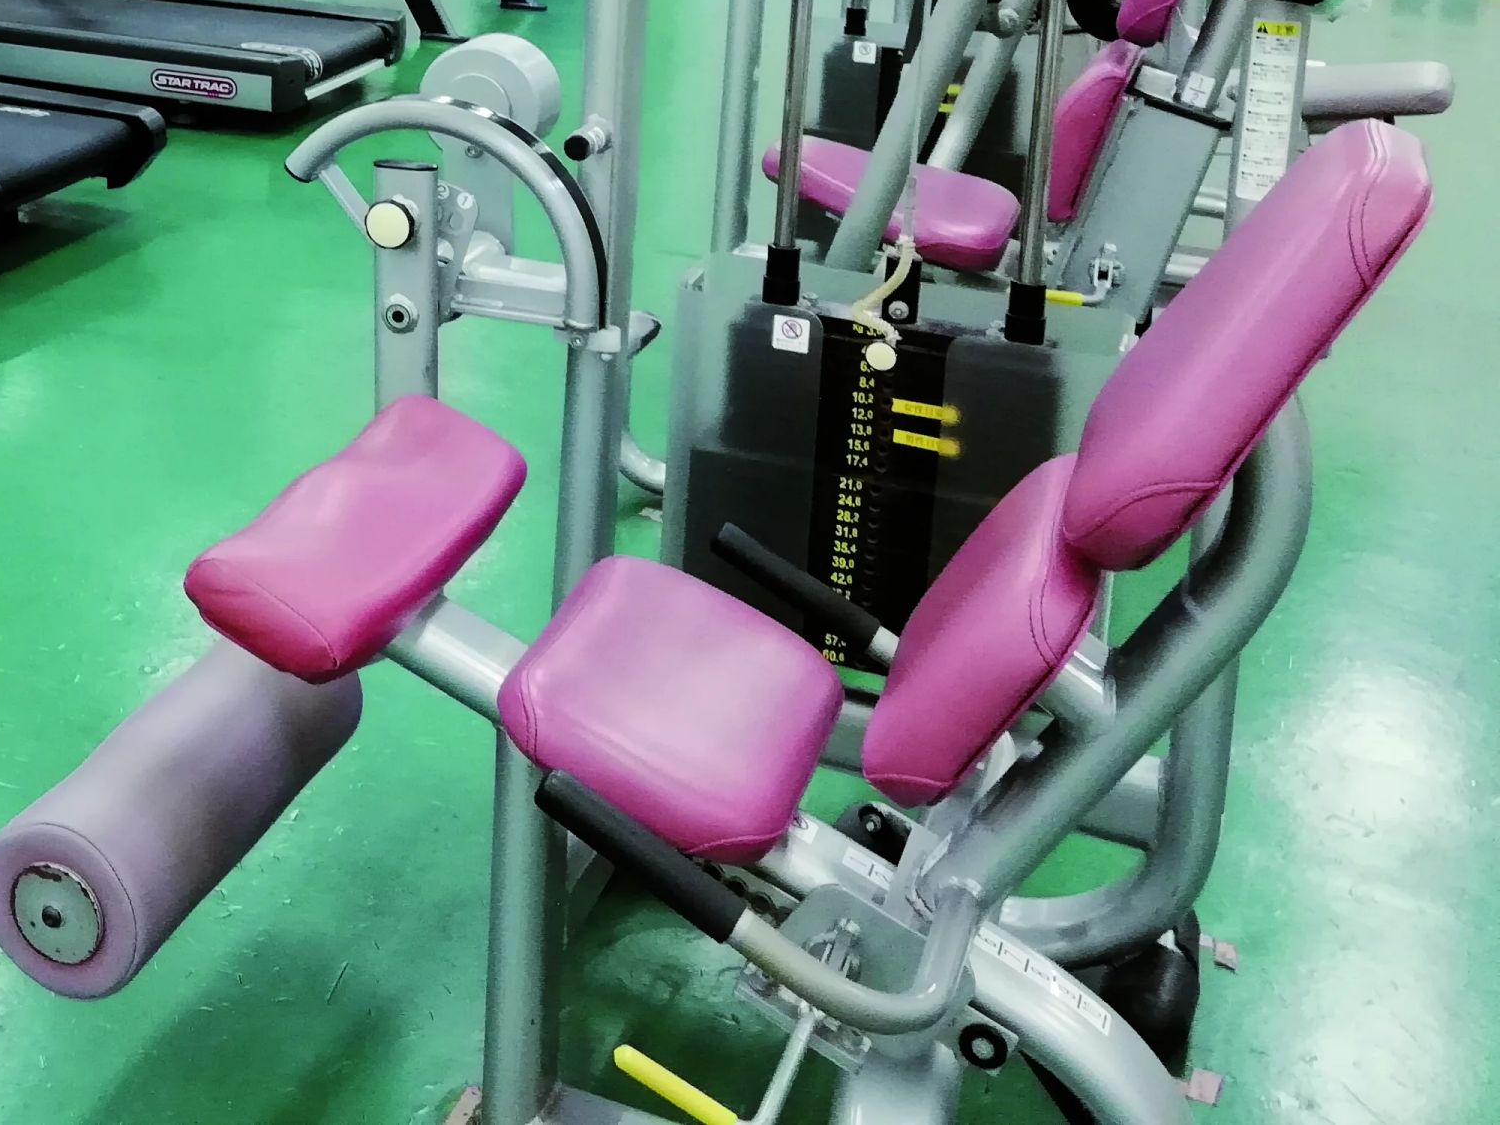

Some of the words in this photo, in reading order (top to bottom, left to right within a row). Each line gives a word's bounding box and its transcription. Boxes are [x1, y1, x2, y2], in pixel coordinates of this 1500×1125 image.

[156, 75, 192, 88] STAR
[193, 81, 231, 93] TRAC
[859, 376, 875, 389] 8.4
[852, 391, 874, 404] 10.2
[851, 407, 874, 420] 12.0
[850, 423, 873, 436] 13.8
[847, 439, 870, 452] 15.6
[846, 454, 869, 467] 17.4
[839, 477, 863, 491] 21.0
[836, 509, 860, 523] 28.2
[833, 540, 857, 554] 35.4
[832, 556, 855, 569] 39.0
